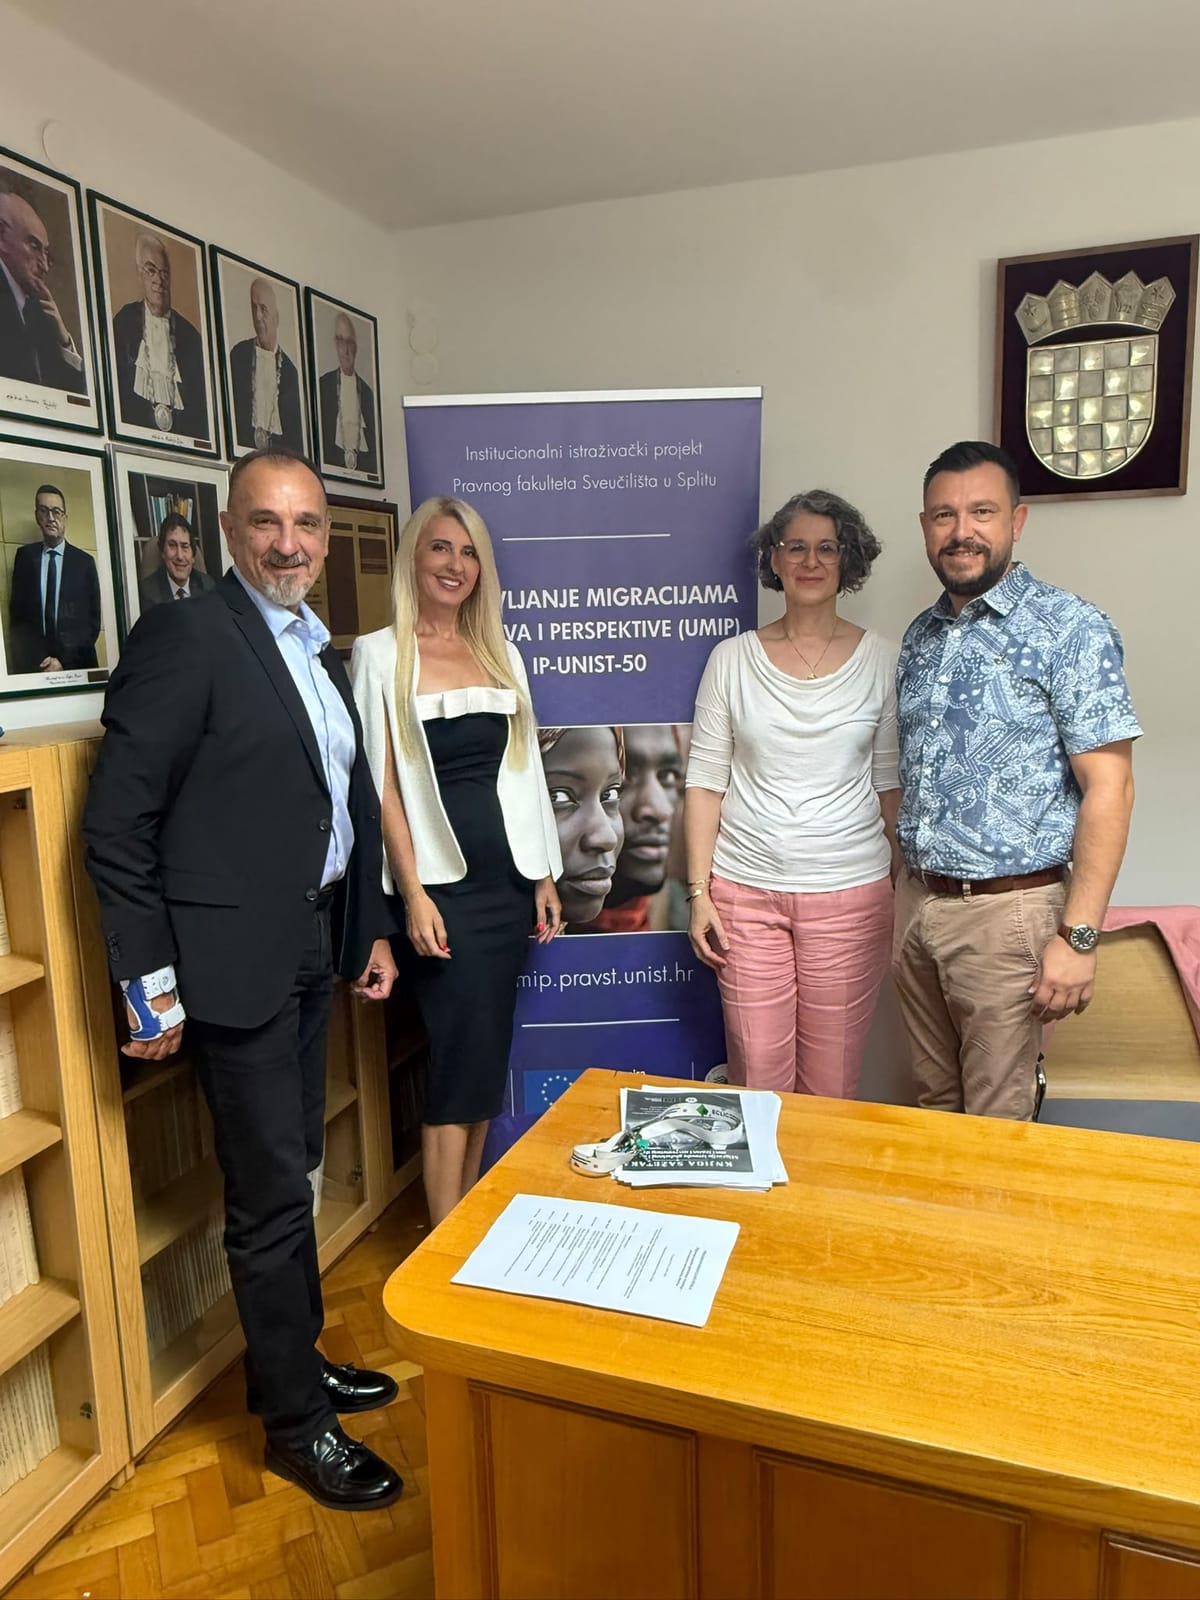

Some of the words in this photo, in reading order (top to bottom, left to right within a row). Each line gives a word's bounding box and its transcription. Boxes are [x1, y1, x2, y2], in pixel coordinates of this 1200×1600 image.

[466, 442, 563, 461] Institucionalni
[568, 440, 648, 459] istraživački
[654, 439, 703, 460] projekt
[453, 478, 512, 497] Pravnog
[517, 474, 577, 492] fakulteta
[582, 472, 658, 490] Sveučilišta
[663, 477, 672, 488] u
[677, 470, 717, 491] Splitu
[501, 588, 579, 609] LJANJE
[586, 584, 738, 608] MIGRACIJAMA
[503, 623, 532, 641] VA
[538, 623, 543, 641] I
[550, 619, 672, 641] PERSPEKTIVE
[678, 617, 740, 642] (UMIP)
[533, 653, 647, 675] IP-UNIST-50
[516, 961, 694, 992] mip.pravst.unist.hr
